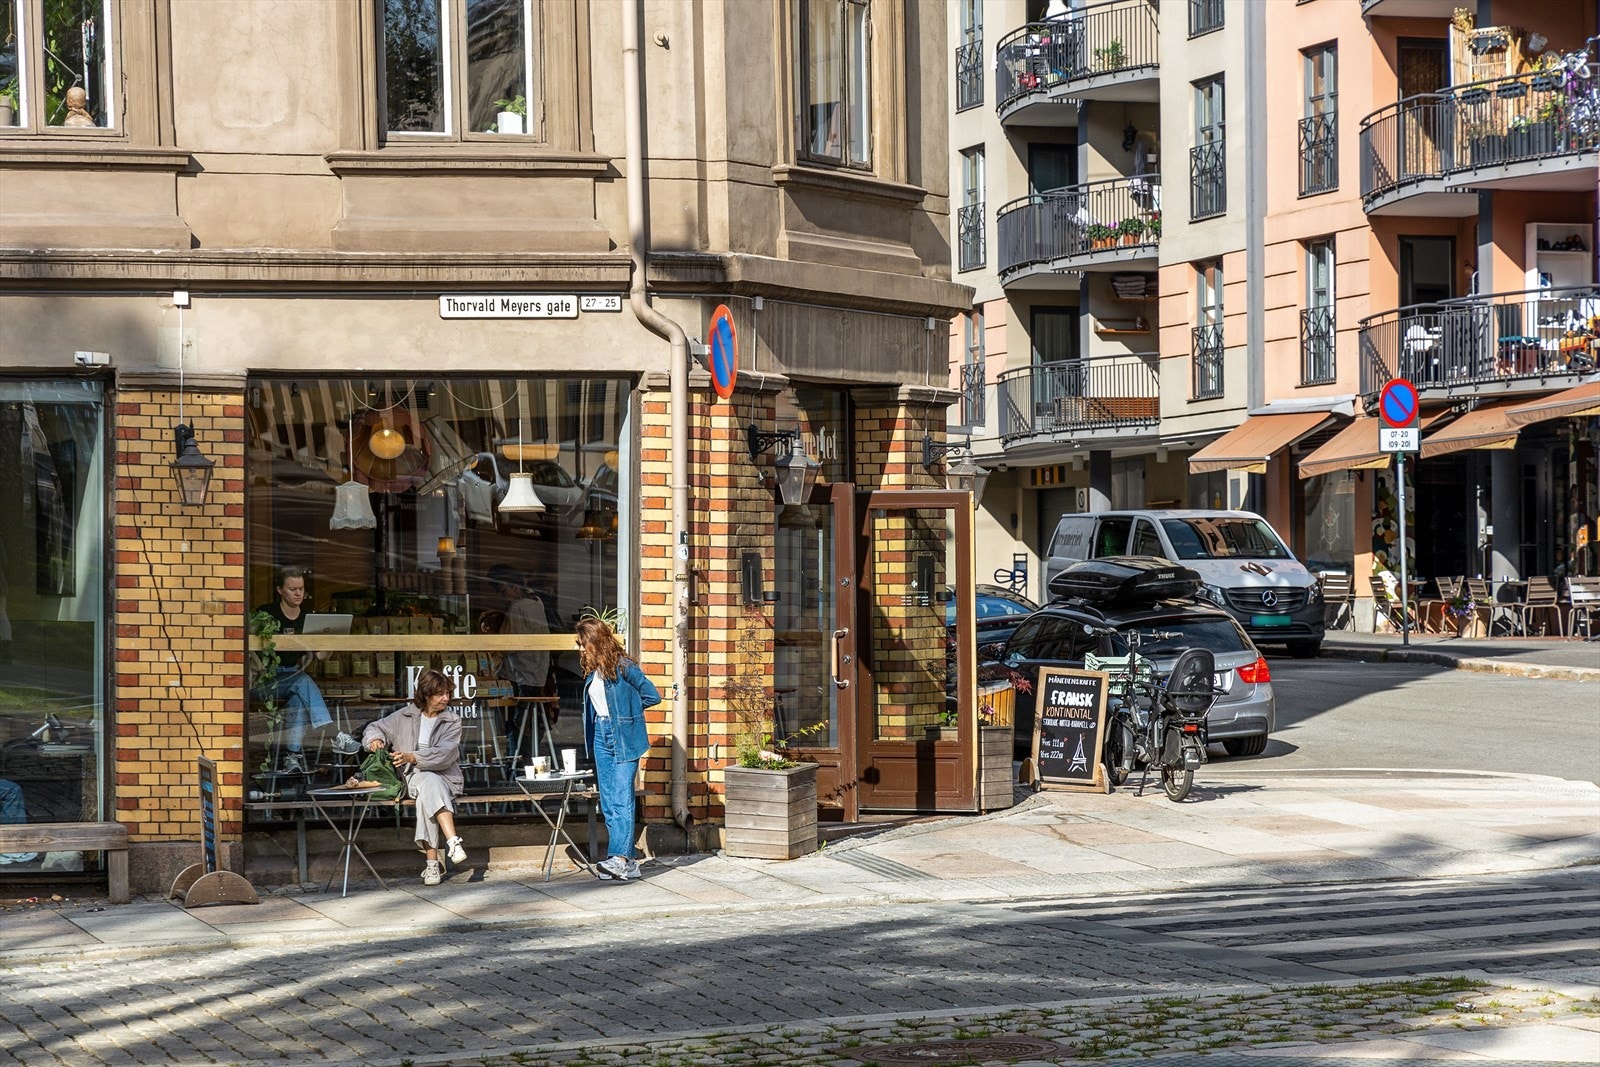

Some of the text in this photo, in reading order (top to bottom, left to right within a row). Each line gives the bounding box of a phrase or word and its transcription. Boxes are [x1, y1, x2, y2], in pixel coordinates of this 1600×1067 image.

[446, 299, 571, 315] Thorvald Meyers gate
[585, 299, 597, 308] 27
[605, 299, 617, 308] 25
[1158, 572, 1175, 580] THULE
[1051, 690, 1094, 707] FRANSK
[1045, 706, 1092, 720] KONTINENTAL
